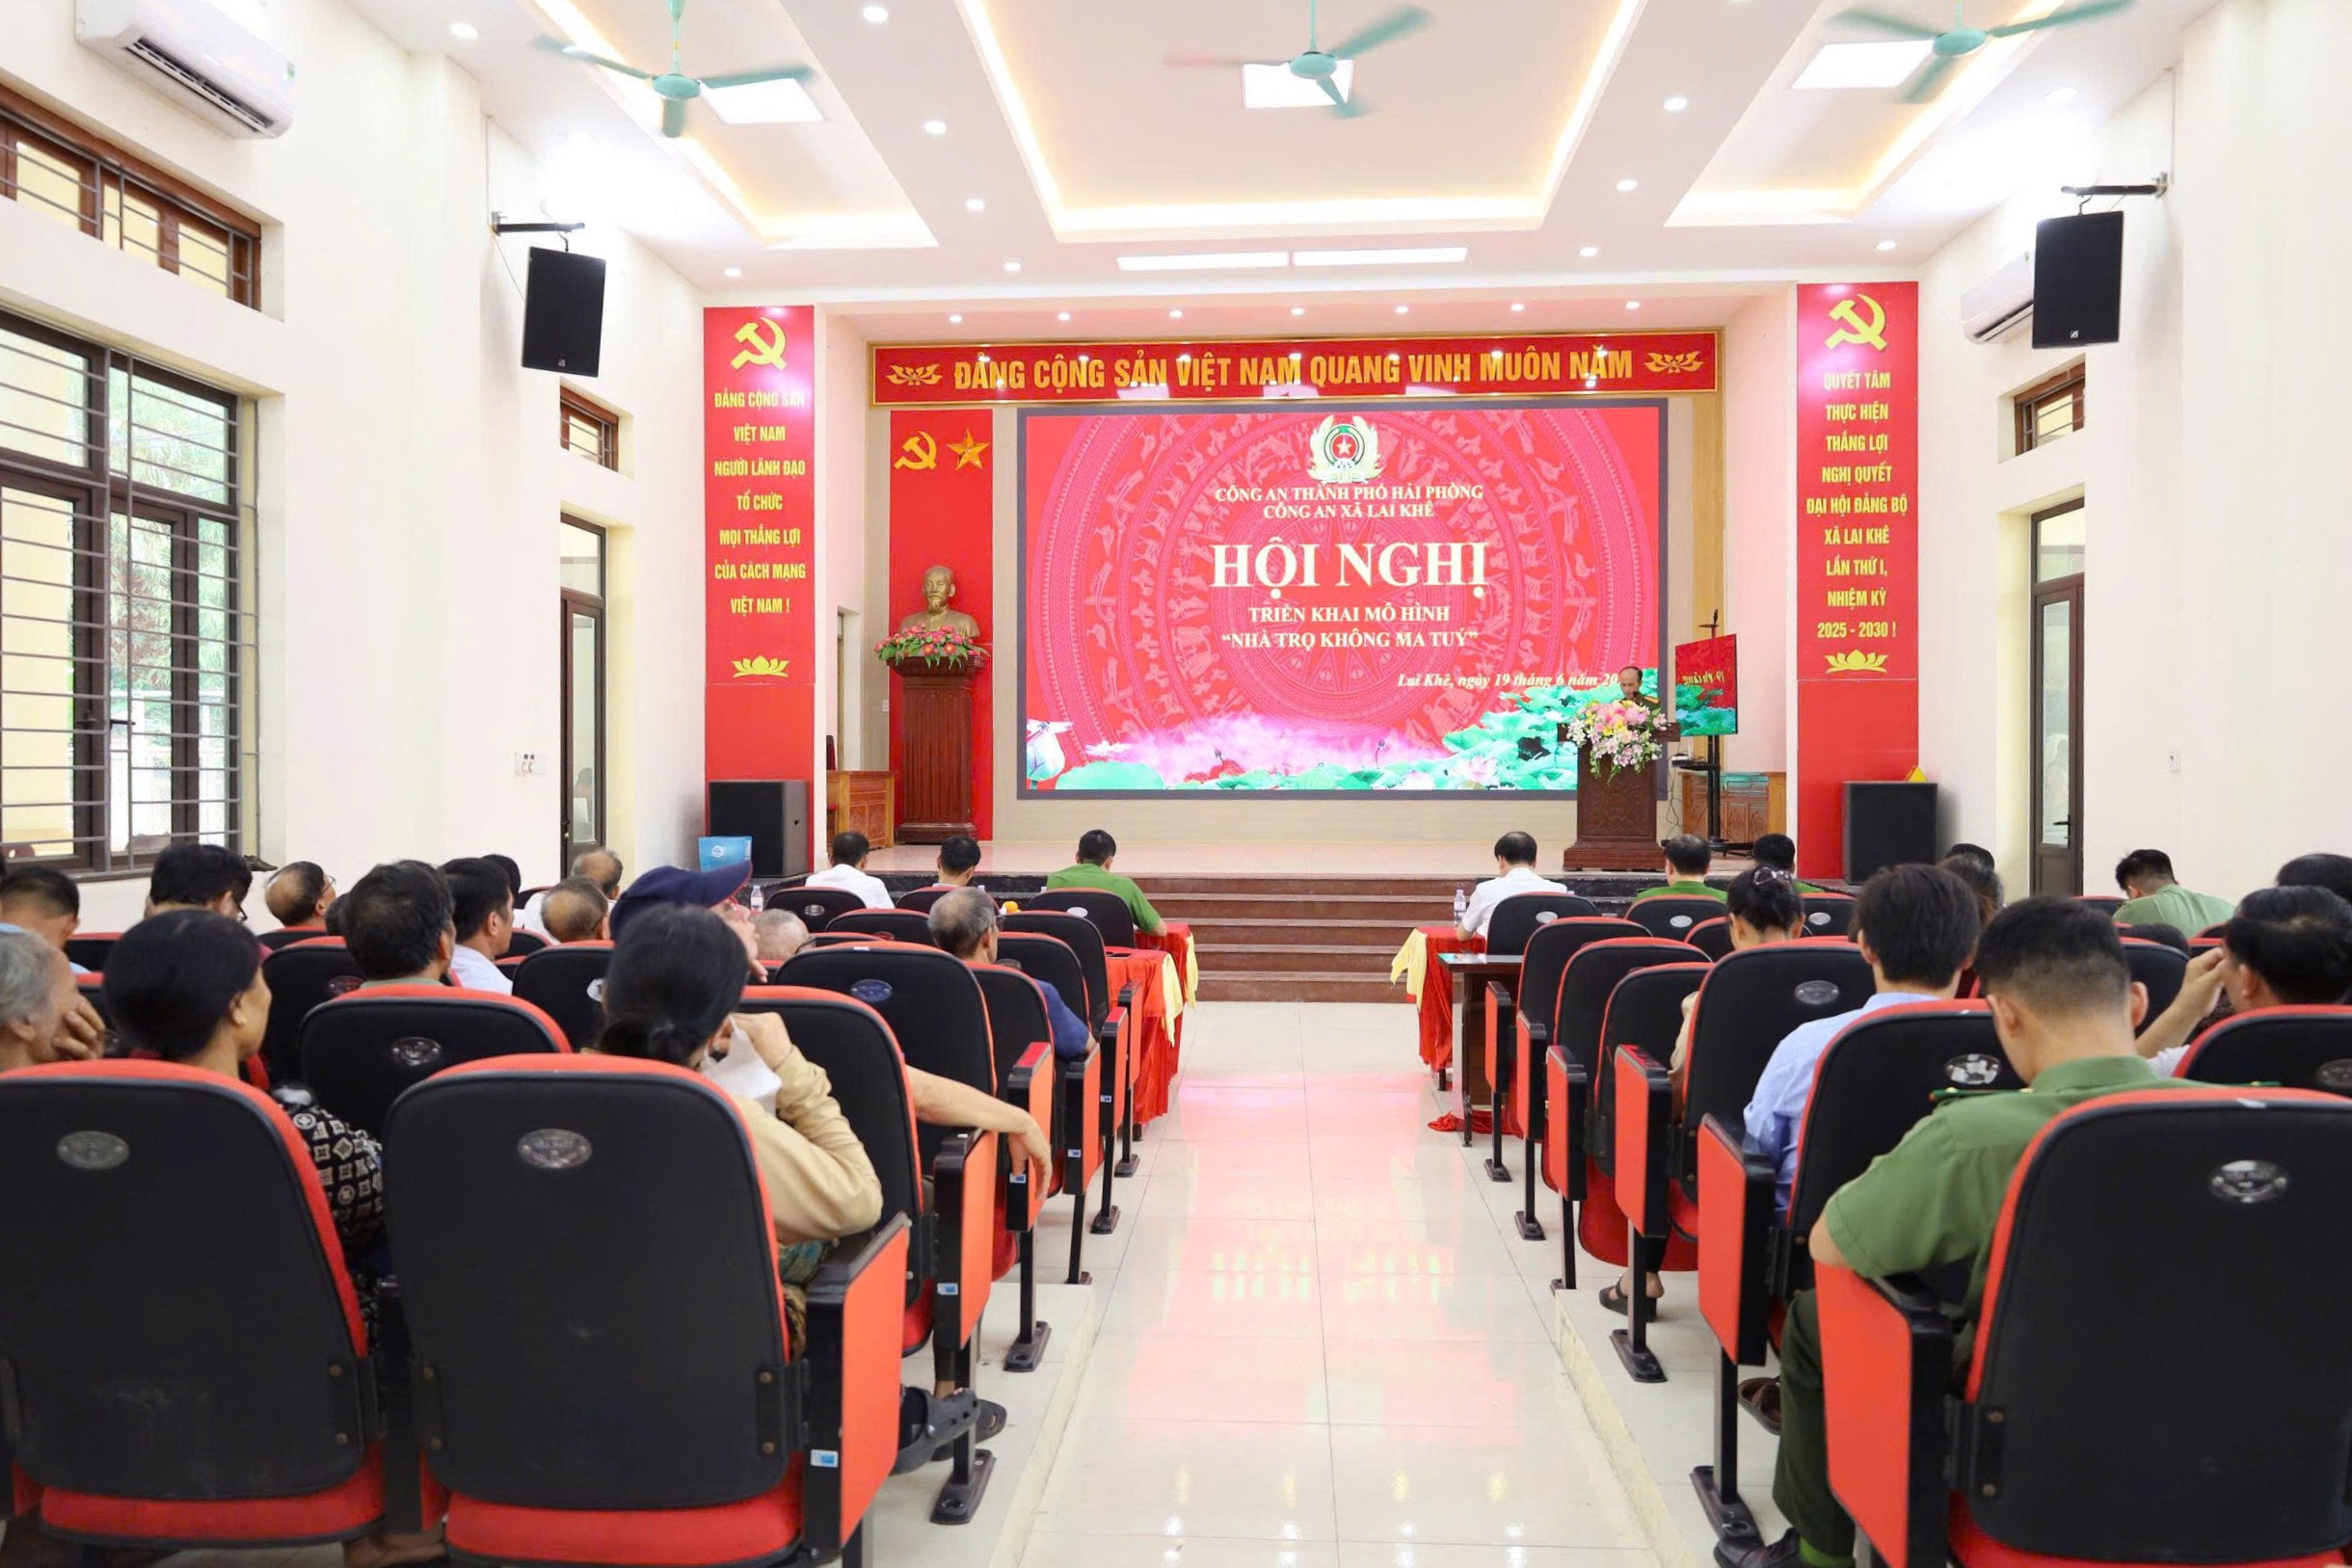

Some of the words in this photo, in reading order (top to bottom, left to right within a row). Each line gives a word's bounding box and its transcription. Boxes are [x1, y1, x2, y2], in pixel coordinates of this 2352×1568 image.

[954, 352, 1025, 389] ĐẢNG
[1033, 353, 1106, 393] CỘNG
[1114, 349, 1167, 387] SẢN
[1175, 352, 1231, 391] VIỆT
[1240, 354, 1300, 385] NAM
[1310, 354, 1400, 387] QUANG
[1407, 353, 1470, 384] VINH
[1480, 345, 1561, 383] MUÔN
[1569, 344, 1633, 380] NĂM
[1823, 370, 1861, 389] QUYẾT
[1864, 369, 1891, 389] TÂM
[714, 387, 745, 408] ĐẢNG
[748, 389, 778, 412] CỘNG
[1825, 402, 1857, 424] THỰC
[1859, 400, 1889, 424] HIỆN
[734, 423, 757, 445] VIỆT
[760, 426, 786, 441] NAM
[1826, 430, 1866, 452] THẮNG
[1869, 432, 1888, 454] LỢI
[714, 458, 748, 477] NGƯỜI
[751, 457, 781, 475] LÃNH
[783, 460, 806, 480] ĐẠO
[1822, 466, 1851, 487] NGHỊ
[1855, 461, 1892, 484] QUYẾT
[736, 489, 751, 510] TỔ
[753, 491, 783, 510] CHỨC
[1216, 484, 1262, 502] CÔNG
[1266, 488, 1288, 501] AN
[1292, 484, 1349, 501] THÀNH
[1392, 483, 1421, 500] HẢI
[1426, 482, 1483, 499] PHÒNG
[1264, 502, 1310, 519] CÔNG
[1313, 505, 1336, 518] AN
[1367, 504, 1396, 518] LAI
[1400, 500, 1434, 518] KHÊ
[1806, 497, 1827, 518] ĐẠI
[1831, 493, 1851, 518] HỘI
[1854, 492, 1887, 514] ĐẢNG
[1891, 493, 1908, 517] BỘ
[720, 529, 740, 548] MỌI
[744, 523, 781, 545] THẮNG
[783, 527, 801, 548] LỢI
[1824, 524, 1841, 545] XÃ
[1844, 528, 1862, 545] LAI
[1866, 524, 1889, 545] KHÊ
[714, 559, 737, 579] CỦA
[739, 561, 769, 579] CÁCH
[772, 564, 806, 582] MẠNG
[1209, 536, 1321, 599] HỘI
[1336, 542, 1490, 598] NGHỊ
[1853, 556, 1878, 576] THỨ
[1880, 559, 1887, 577] I,
[731, 595, 754, 617] VIỆT
[757, 598, 783, 614] NAM
[1828, 587, 1867, 610] NHIỆM
[1311, 606, 1360, 622] KHAI
[1365, 602, 1397, 622] MÔ
[1401, 601, 1450, 622] HÌNH
[1277, 632, 1316, 651] TRỌ
[1320, 627, 1391, 648] KHÔNG
[1395, 632, 1426, 648] MA
[1817, 622, 1847, 638] 2025
[1858, 621, 1889, 638] 2030
[1398, 674, 1421, 687] Lai
[1424, 672, 1455, 690] Khê,
[1457, 674, 1490, 690] ngày
[1494, 674, 1510, 687] 19
[1513, 673, 1552, 690] tháng
[1556, 674, 1564, 687] 6
[1568, 674, 1599, 687] năm
